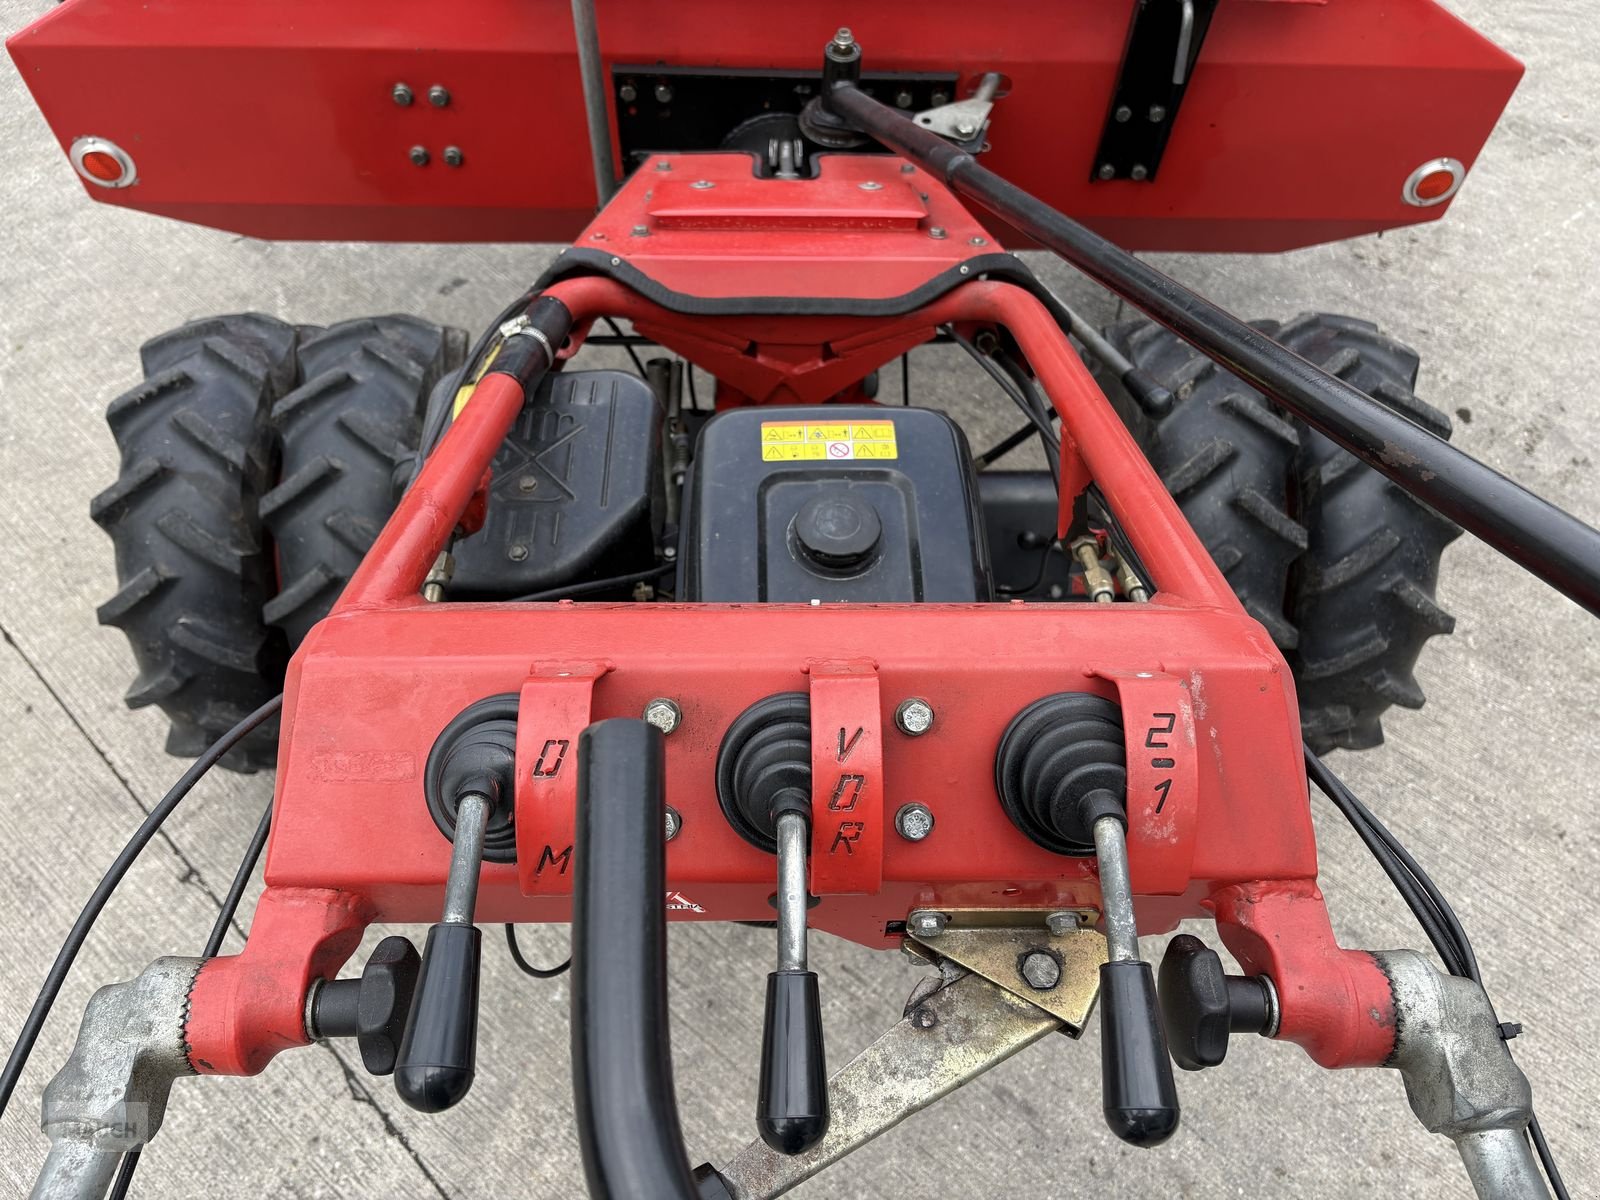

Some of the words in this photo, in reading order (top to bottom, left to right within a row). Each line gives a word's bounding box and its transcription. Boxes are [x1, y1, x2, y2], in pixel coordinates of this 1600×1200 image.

[838, 727, 864, 763] V
[1145, 712, 1176, 748] 2
[1154, 779, 1173, 814] 1
[830, 822, 864, 855] R
[536, 845, 574, 875] M
